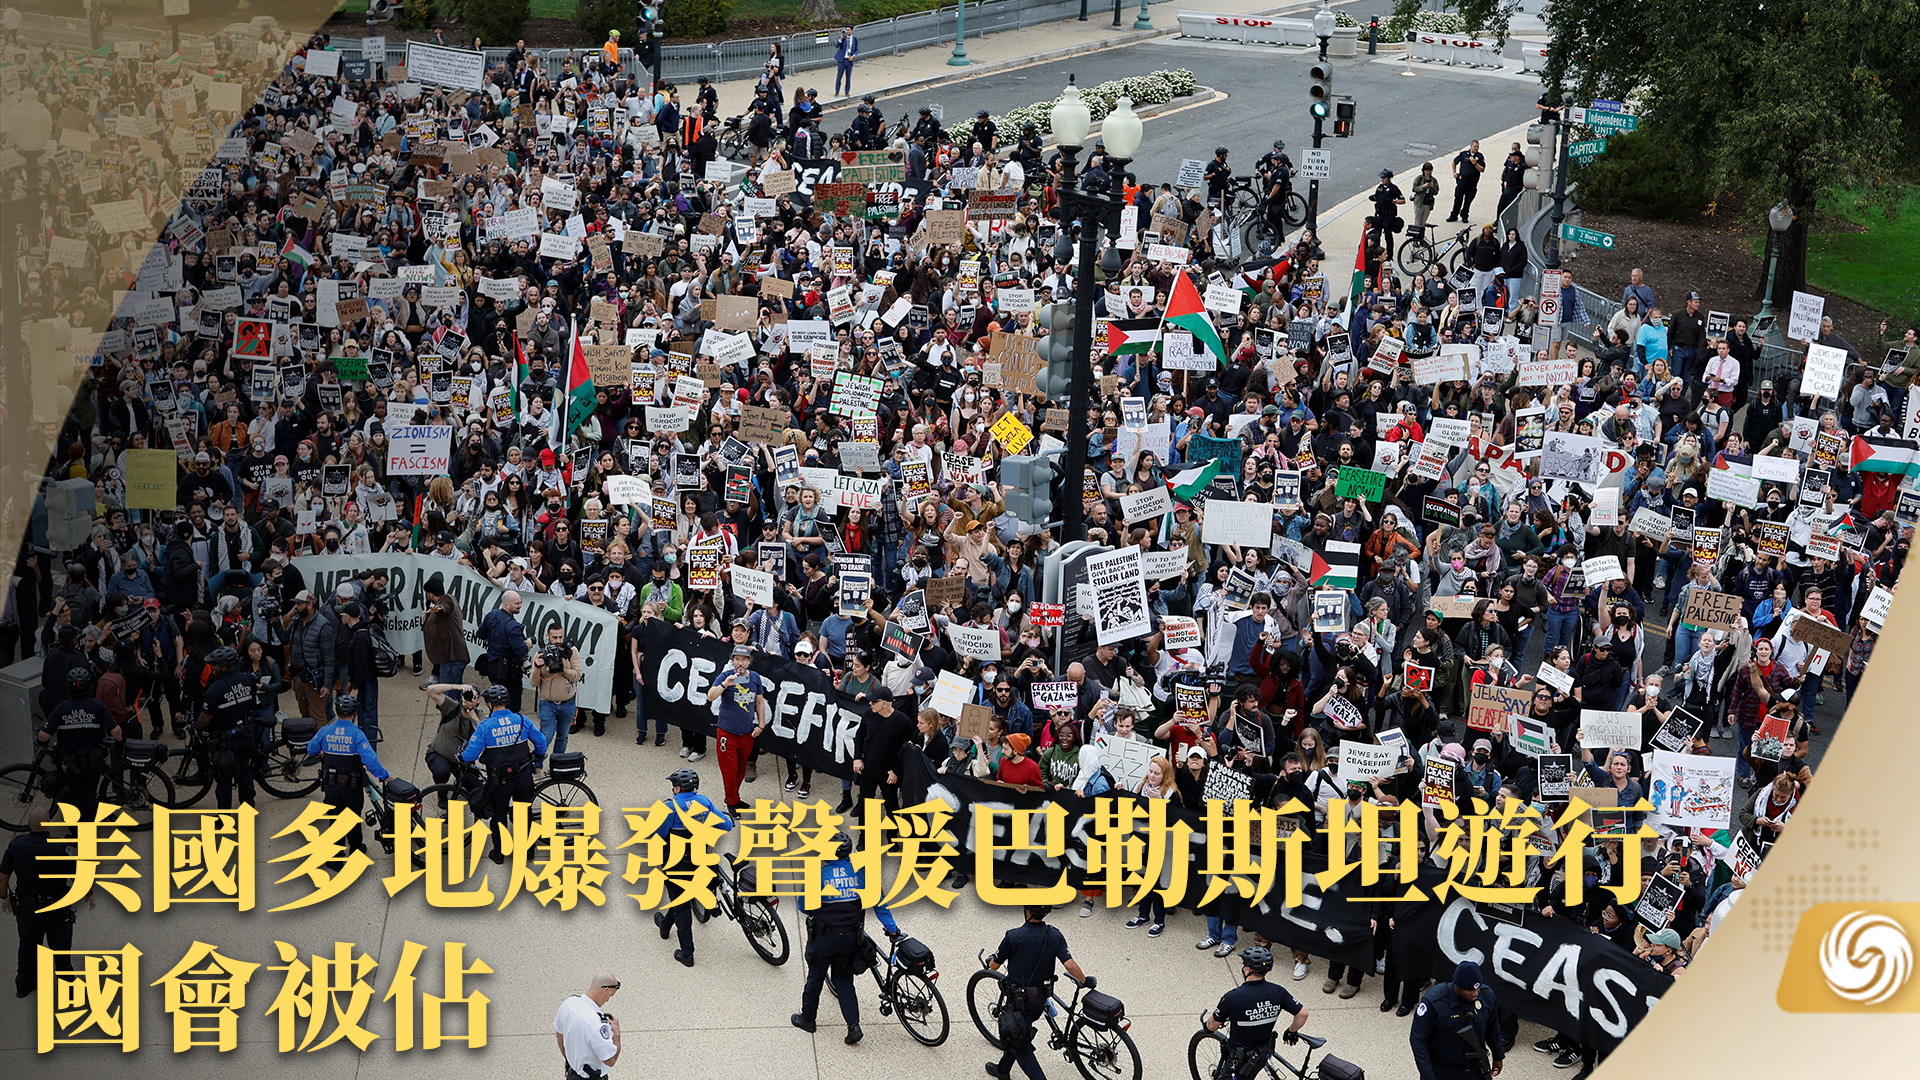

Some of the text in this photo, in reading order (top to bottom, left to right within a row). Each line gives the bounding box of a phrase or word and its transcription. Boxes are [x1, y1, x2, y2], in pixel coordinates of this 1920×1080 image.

[1216, 17, 1273, 28] STOP
[1421, 36, 1484, 49] STOP
[1588, 111, 1626, 127] Independence
[1594, 126, 1613, 134] UNIT
[1568, 143, 1598, 156] CAPITOL
[858, 153, 888, 165] FREE
[1579, 155, 1593, 163] 100
[183, 171, 220, 179] JEWS SAY
[842, 167, 905, 182] PALESTINE
[183, 179, 220, 188] CEASEFIRE
[350, 191, 373, 200] NOW
[874, 193, 894, 204] FREE
[868, 205, 898, 216] PALESTINE
[931, 221, 959, 230] FREE
[1154, 215, 1188, 231] CEASEFIRE
[1150, 245, 1163, 256] FREE
[594, 253, 609, 261] FREE
[406, 273, 435, 284] NOW!
[341, 306, 362, 316] NOW
[1289, 340, 1309, 349] NOW
[1813, 348, 1843, 359] JEWS SAY
[1166, 360, 1215, 369] COLONIZATION
[1524, 363, 1575, 373] NEVER AGAIN
[337, 368, 358, 378] NOW
[1279, 367, 1296, 380] GAZA
[1546, 372, 1576, 384] ANYONE
[1813, 372, 1836, 382] PEOPLE
[845, 382, 871, 392] JEWISH
[1814, 381, 1835, 394] GAZA
[841, 389, 873, 399] SOLIDARITY
[840, 398, 870, 408] PALESTINE
[992, 418, 1011, 434] LET
[391, 427, 450, 439] ZIONISM
[391, 457, 447, 470] FASCISM
[943, 453, 974, 466] CEASE
[903, 468, 927, 476] CEASE
[1339, 467, 1385, 488] CEASEFIRE
[834, 477, 879, 494] LET GAZA
[1347, 484, 1376, 500] NOW!
[841, 493, 873, 508] LIVE
[1128, 499, 1165, 513] GENOCIDE
[1135, 496, 1155, 505] STOP
[1145, 506, 1162, 515] GAZA
[1207, 502, 1272, 519] PALESTINIAN
[1425, 504, 1459, 518] OCCUPATION
[1649, 515, 1667, 525] STOP
[1221, 519, 1256, 534] LIVES
[1212, 530, 1258, 545] MATTER
[1648, 528, 1666, 538] GAZA
[1764, 528, 1788, 537] CEASE
[1695, 534, 1719, 543] CEASE
[1763, 535, 1783, 544] FIRE
[1761, 540, 1785, 549] GAZA
[1694, 551, 1717, 559] GAZA
[1090, 553, 1139, 571] FREE PALESTINE!
[1145, 566, 1184, 575] APARTHEID
[1093, 569, 1140, 586] STOLEN LAND
[734, 579, 768, 591] CEASEFIRE
[1695, 591, 1736, 611] FREE
[1432, 603, 1448, 612] END
[1046, 615, 1064, 624] NAME
[961, 633, 983, 641] STOP
[1167, 636, 1198, 644] GENOCIDE
[954, 638, 994, 649] GENOCIDE
[966, 647, 990, 655] GAZA
[1032, 683, 1075, 692] CEASEFIRE
[1041, 691, 1064, 702] GAZA
[1066, 692, 1078, 701] NOW
[1178, 693, 1205, 702] CEASE
[1473, 684, 1530, 716] JEWS SAY
[1180, 701, 1203, 709] FIRE
[1334, 705, 1356, 726] GAZA
[1595, 713, 1620, 724] JEWS
[498, 717, 511, 726] U.S.
[335, 727, 345, 736] U.S.
[492, 725, 522, 737] CAPITOL
[1588, 725, 1633, 736] AGAINST
[326, 734, 353, 744] CAPITOL
[496, 734, 522, 746] POLICE
[1584, 734, 1638, 746] APARTHEID
[328, 743, 351, 752] POLICE
[1348, 748, 1392, 759] JEWS SAY:
[1346, 757, 1391, 767] CEASEFIRE
[1209, 760, 1252, 785] IF YOU ARE
[1357, 767, 1380, 775] NOW
[1427, 767, 1452, 780] CEASE
[1428, 777, 1450, 787] FIRE
[1425, 787, 1453, 799] GAZA
[833, 868, 848, 877] U.S.
[824, 877, 859, 888] CAPITOL
[1256, 1000, 1272, 1008] U.S.
[1245, 1005, 1281, 1016] CAPITOL
[1250, 1011, 1278, 1022] POLICE
